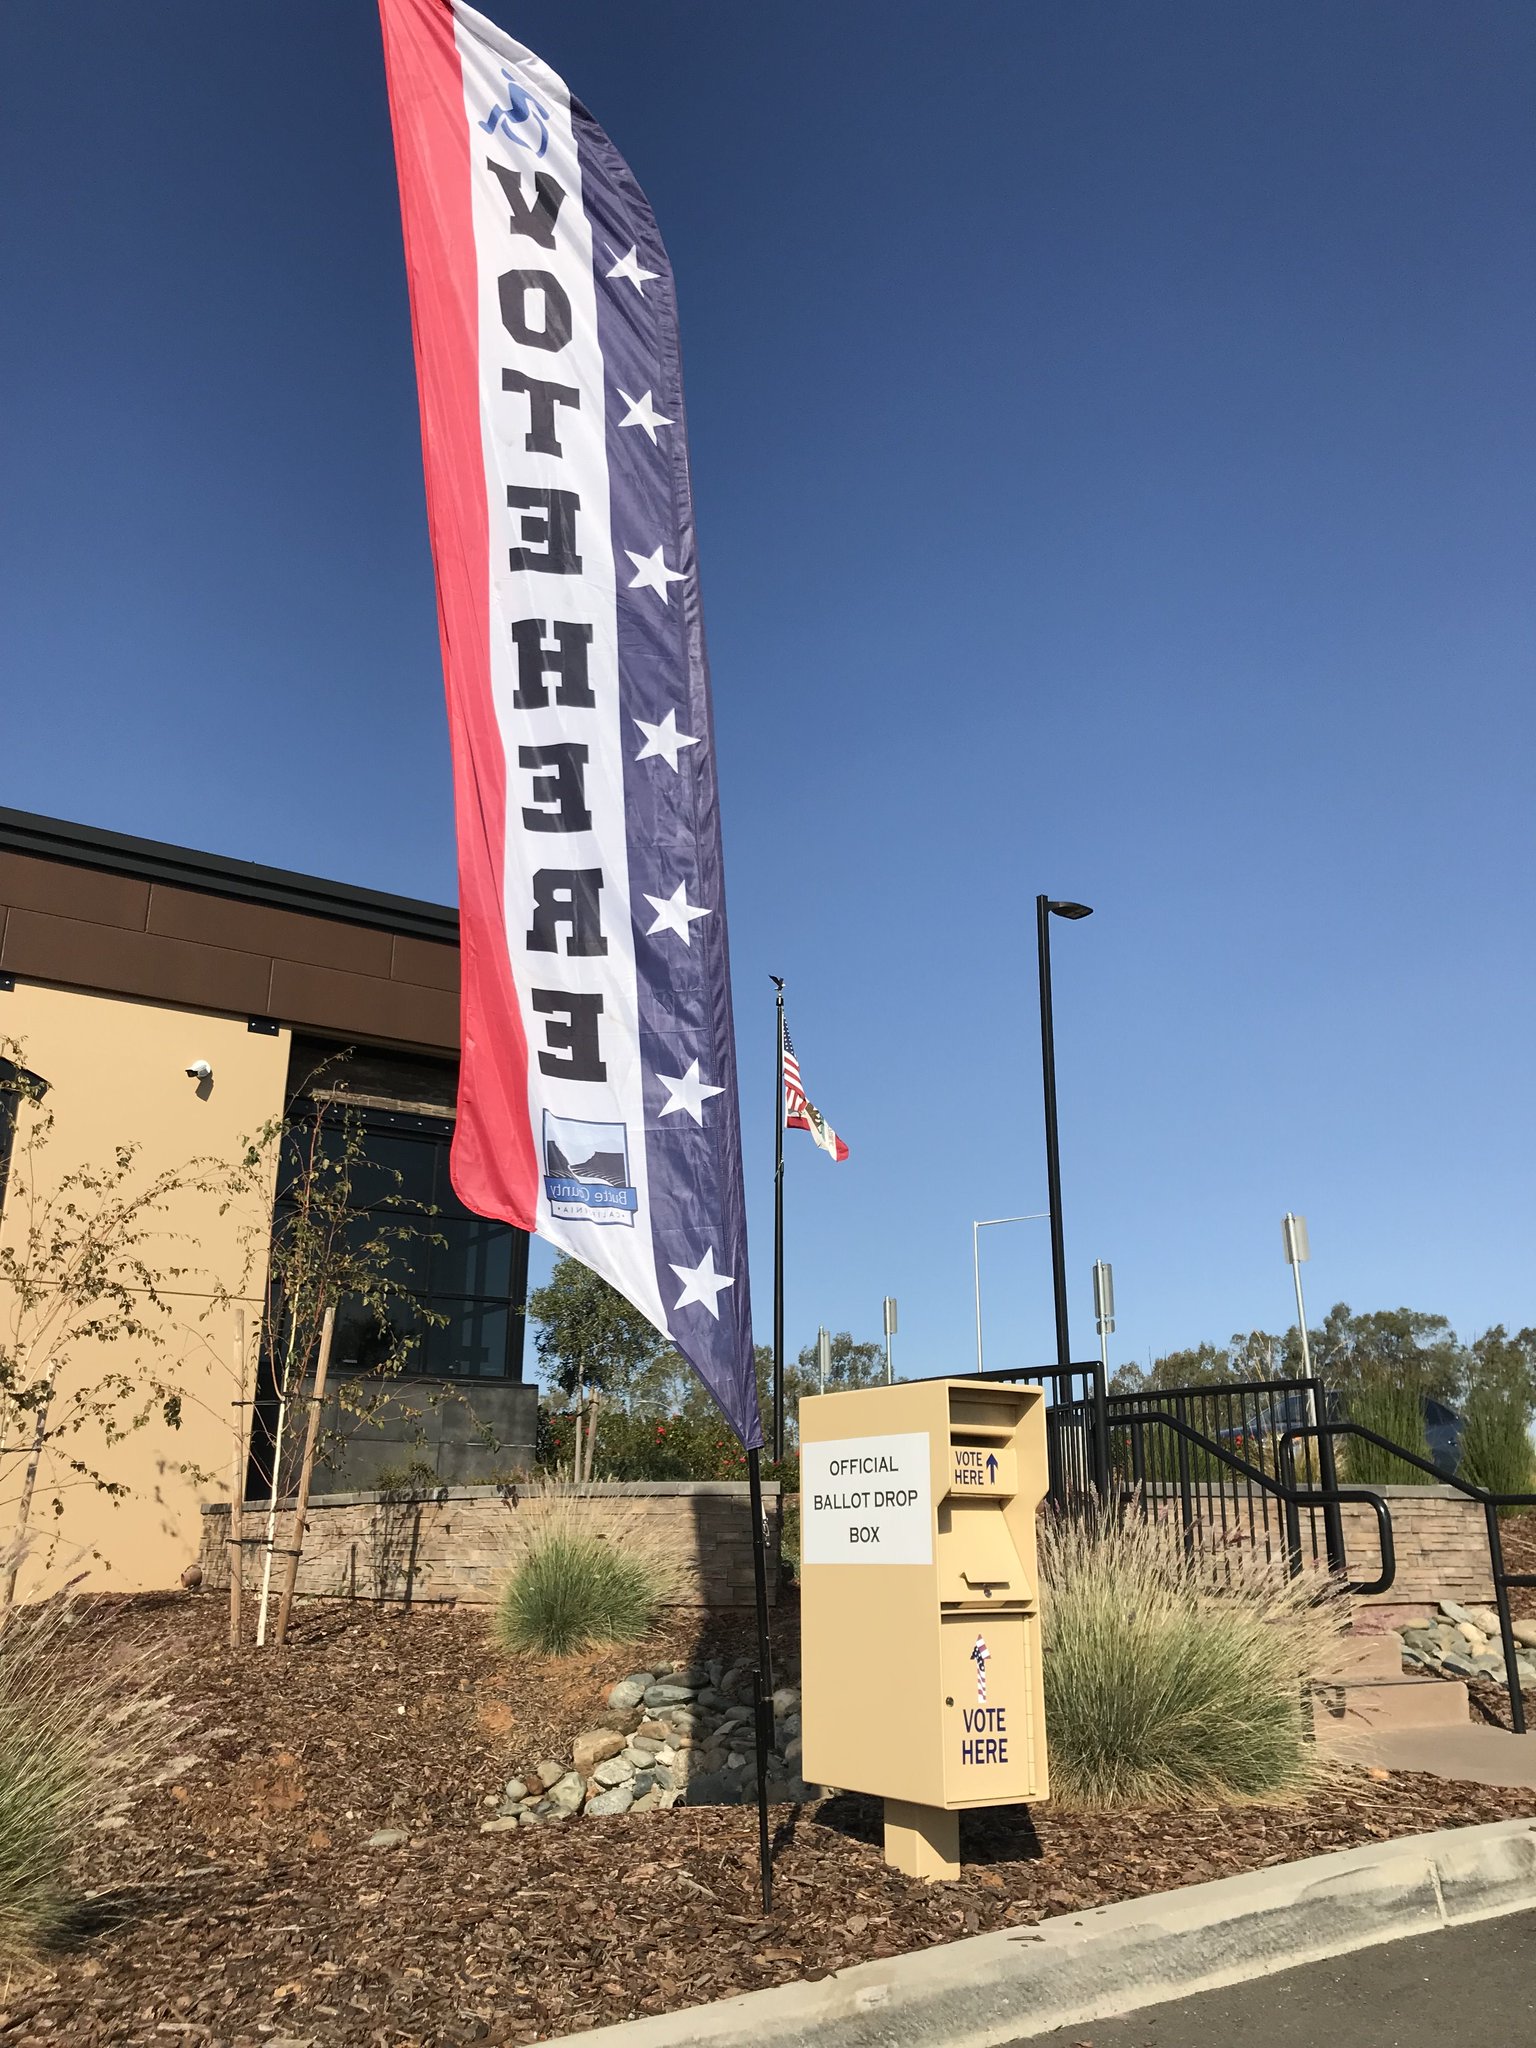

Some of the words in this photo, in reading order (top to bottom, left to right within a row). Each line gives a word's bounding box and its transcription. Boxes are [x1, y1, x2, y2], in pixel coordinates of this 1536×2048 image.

[829, 1456, 899, 1476] OFFICIAL
[955, 1451, 983, 1468] VOTE
[954, 1469, 984, 1486] HERE
[813, 1492, 871, 1511] BALLOT
[874, 1490, 919, 1507] DROP
[849, 1526, 881, 1543] BOX
[962, 1707, 1007, 1733] VOTE
[962, 1738, 1009, 1765] HERE
